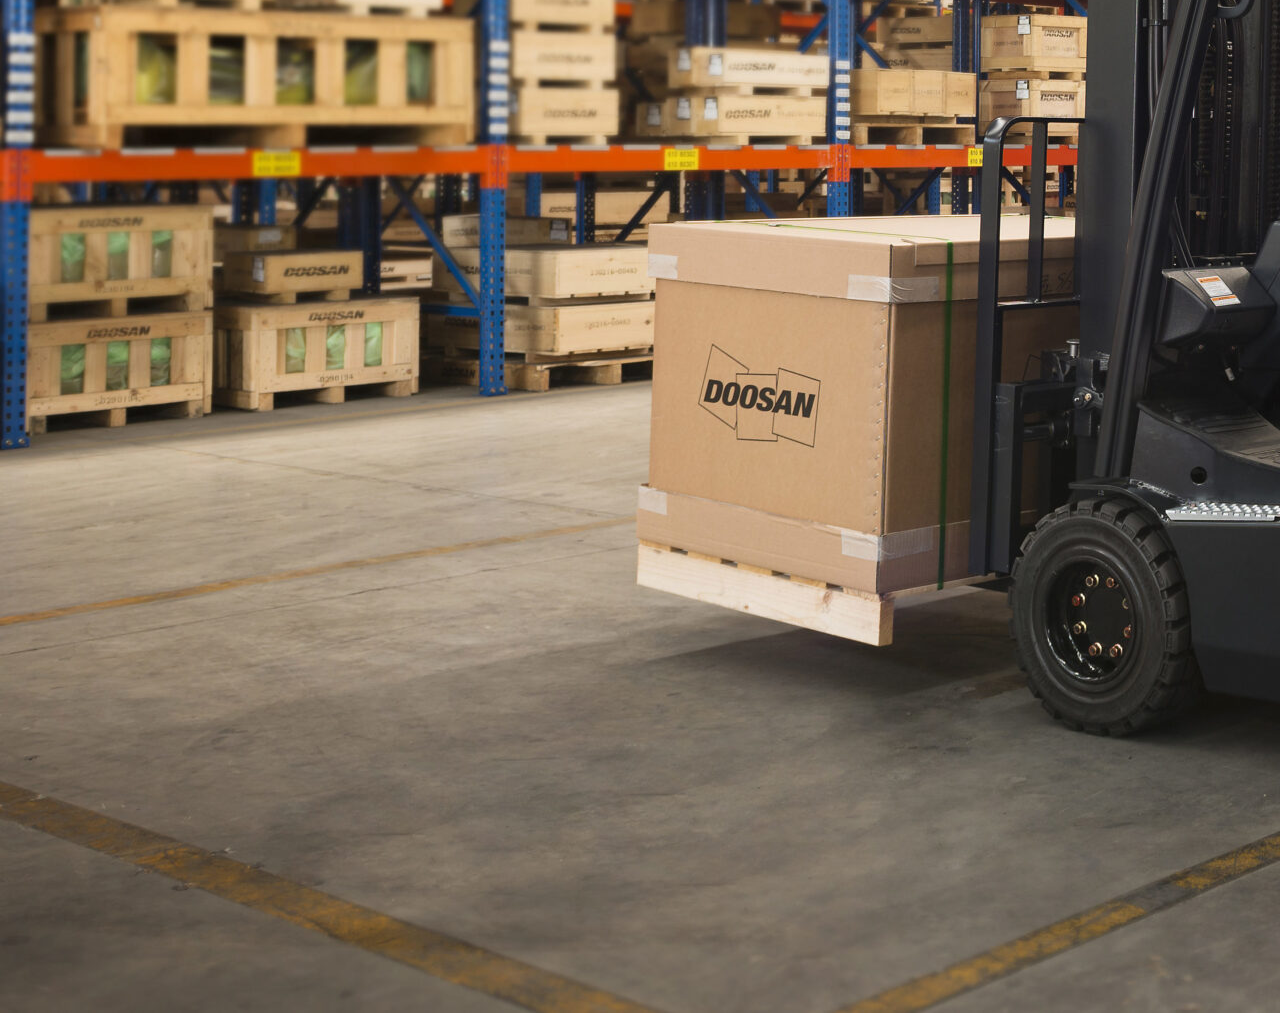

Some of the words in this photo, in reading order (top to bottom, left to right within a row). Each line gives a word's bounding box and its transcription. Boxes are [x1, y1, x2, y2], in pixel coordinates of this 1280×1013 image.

[1044, 29, 1075, 38] DOOSAN
[1040, 93, 1075, 102] DOOSAN
[725, 109, 772, 119] DOOSAN
[78, 217, 144, 228] DOOSAN
[283, 265, 350, 277] DOOSAN
[308, 310, 365, 321] DOOSAN
[86, 325, 151, 339] DOOSAN
[703, 379, 816, 418] DOOSAN
